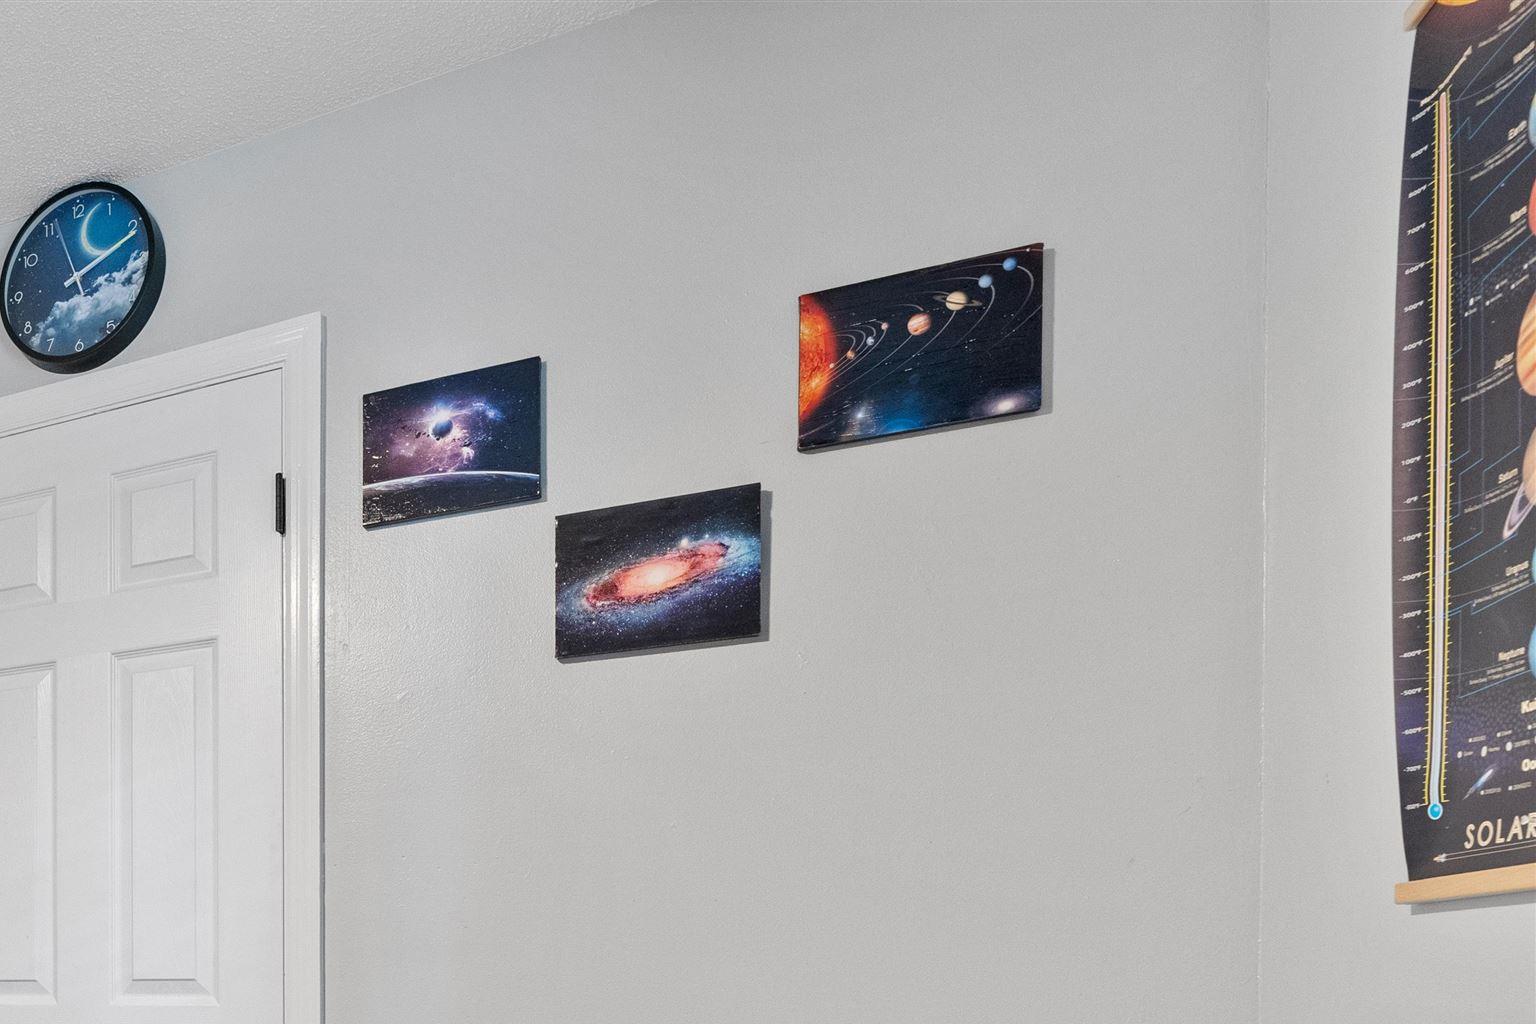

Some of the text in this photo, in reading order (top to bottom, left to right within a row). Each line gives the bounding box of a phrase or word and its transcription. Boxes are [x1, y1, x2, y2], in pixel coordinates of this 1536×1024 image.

[72, 203, 85, 220] 12
[107, 202, 112, 216] 1
[44, 222, 54, 238] 11
[127, 219, 138, 233] 2
[24, 253, 39, 269] 10
[14, 291, 23, 304] 9
[24, 321, 32, 334] 8
[106, 320, 116, 334] 5
[46, 338, 54, 352] 7
[75, 338, 84, 352] 6
